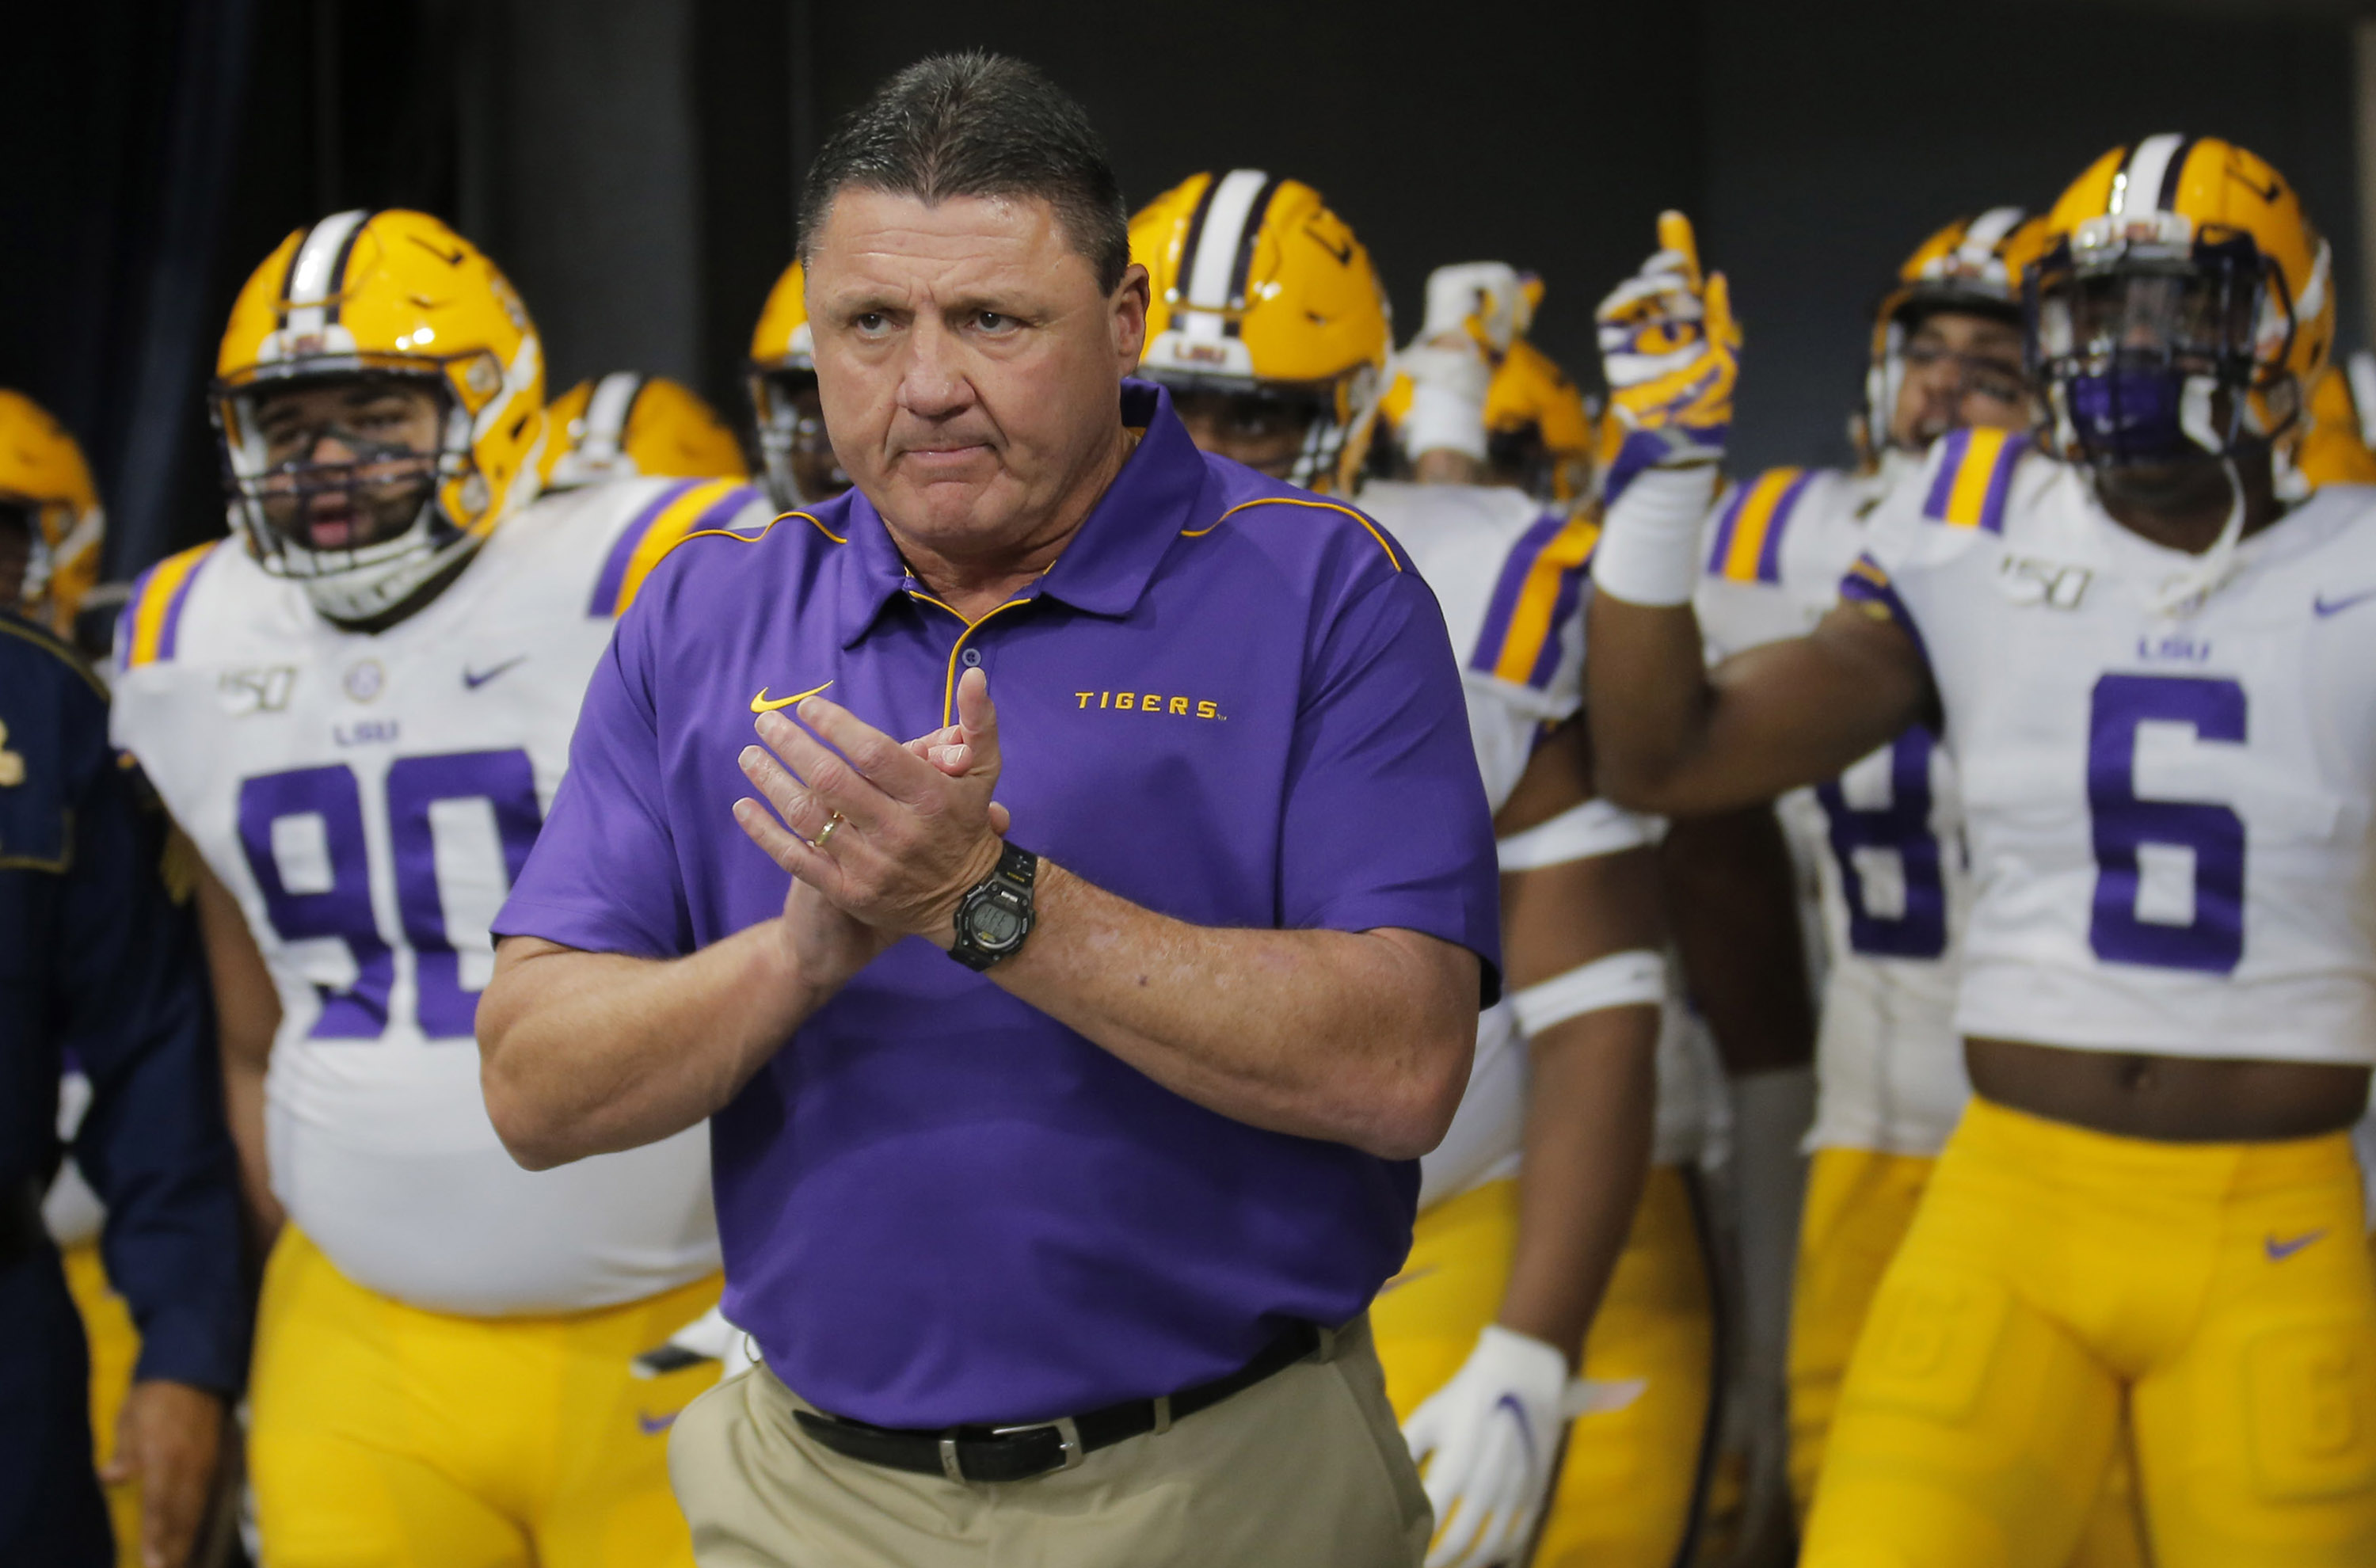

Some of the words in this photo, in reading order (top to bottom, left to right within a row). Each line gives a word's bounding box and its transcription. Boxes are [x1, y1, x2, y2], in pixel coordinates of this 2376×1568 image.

[333, 720, 401, 747] LSU
[1075, 691, 1218, 719] TIGERS
[237, 748, 544, 1041] 90
[2088, 672, 2247, 978] 6
